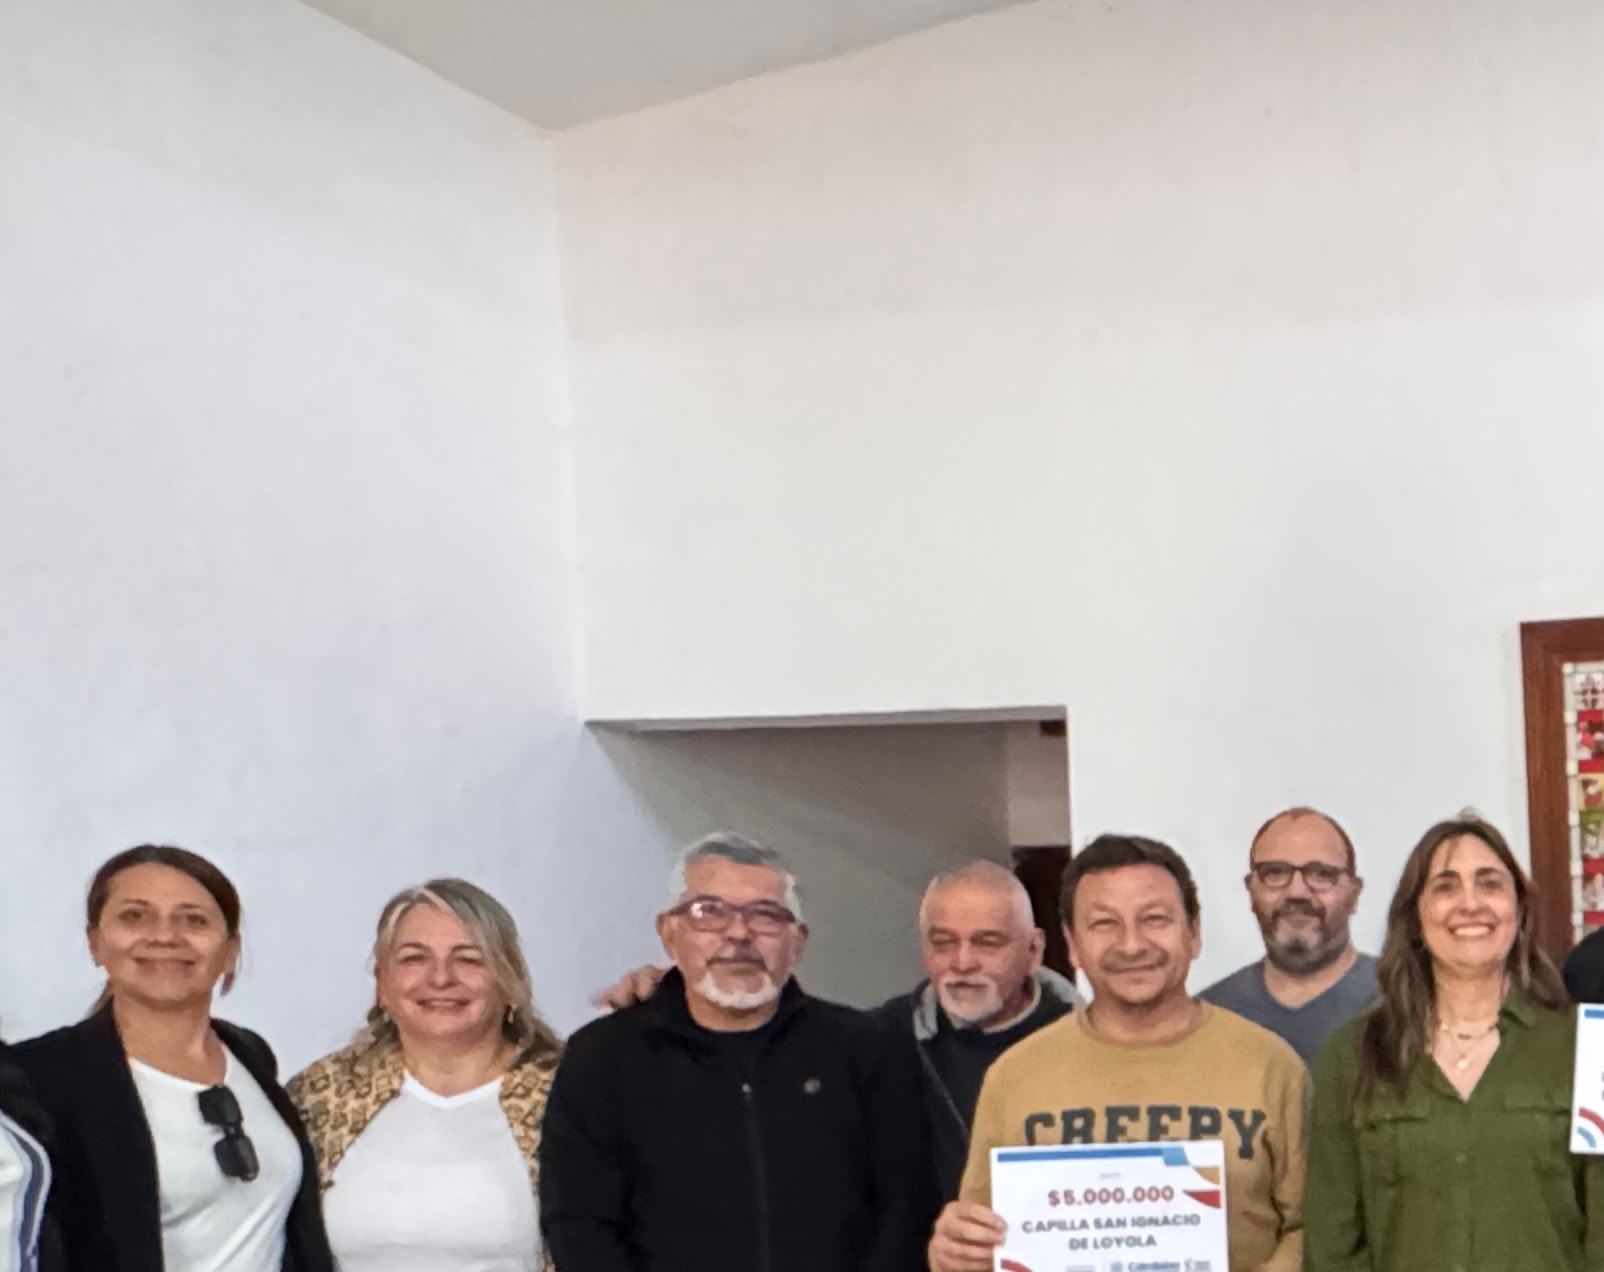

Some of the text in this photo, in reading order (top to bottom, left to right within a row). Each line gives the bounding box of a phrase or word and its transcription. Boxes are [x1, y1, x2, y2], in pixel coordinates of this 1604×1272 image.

[1023, 1105, 1267, 1160] CREEPY
[1047, 1185, 1175, 1208] $5.000.000
[1021, 1213, 1202, 1234] CAPILLA SAN IGNACIO
[1068, 1234, 1158, 1251] DE LOYOLA
